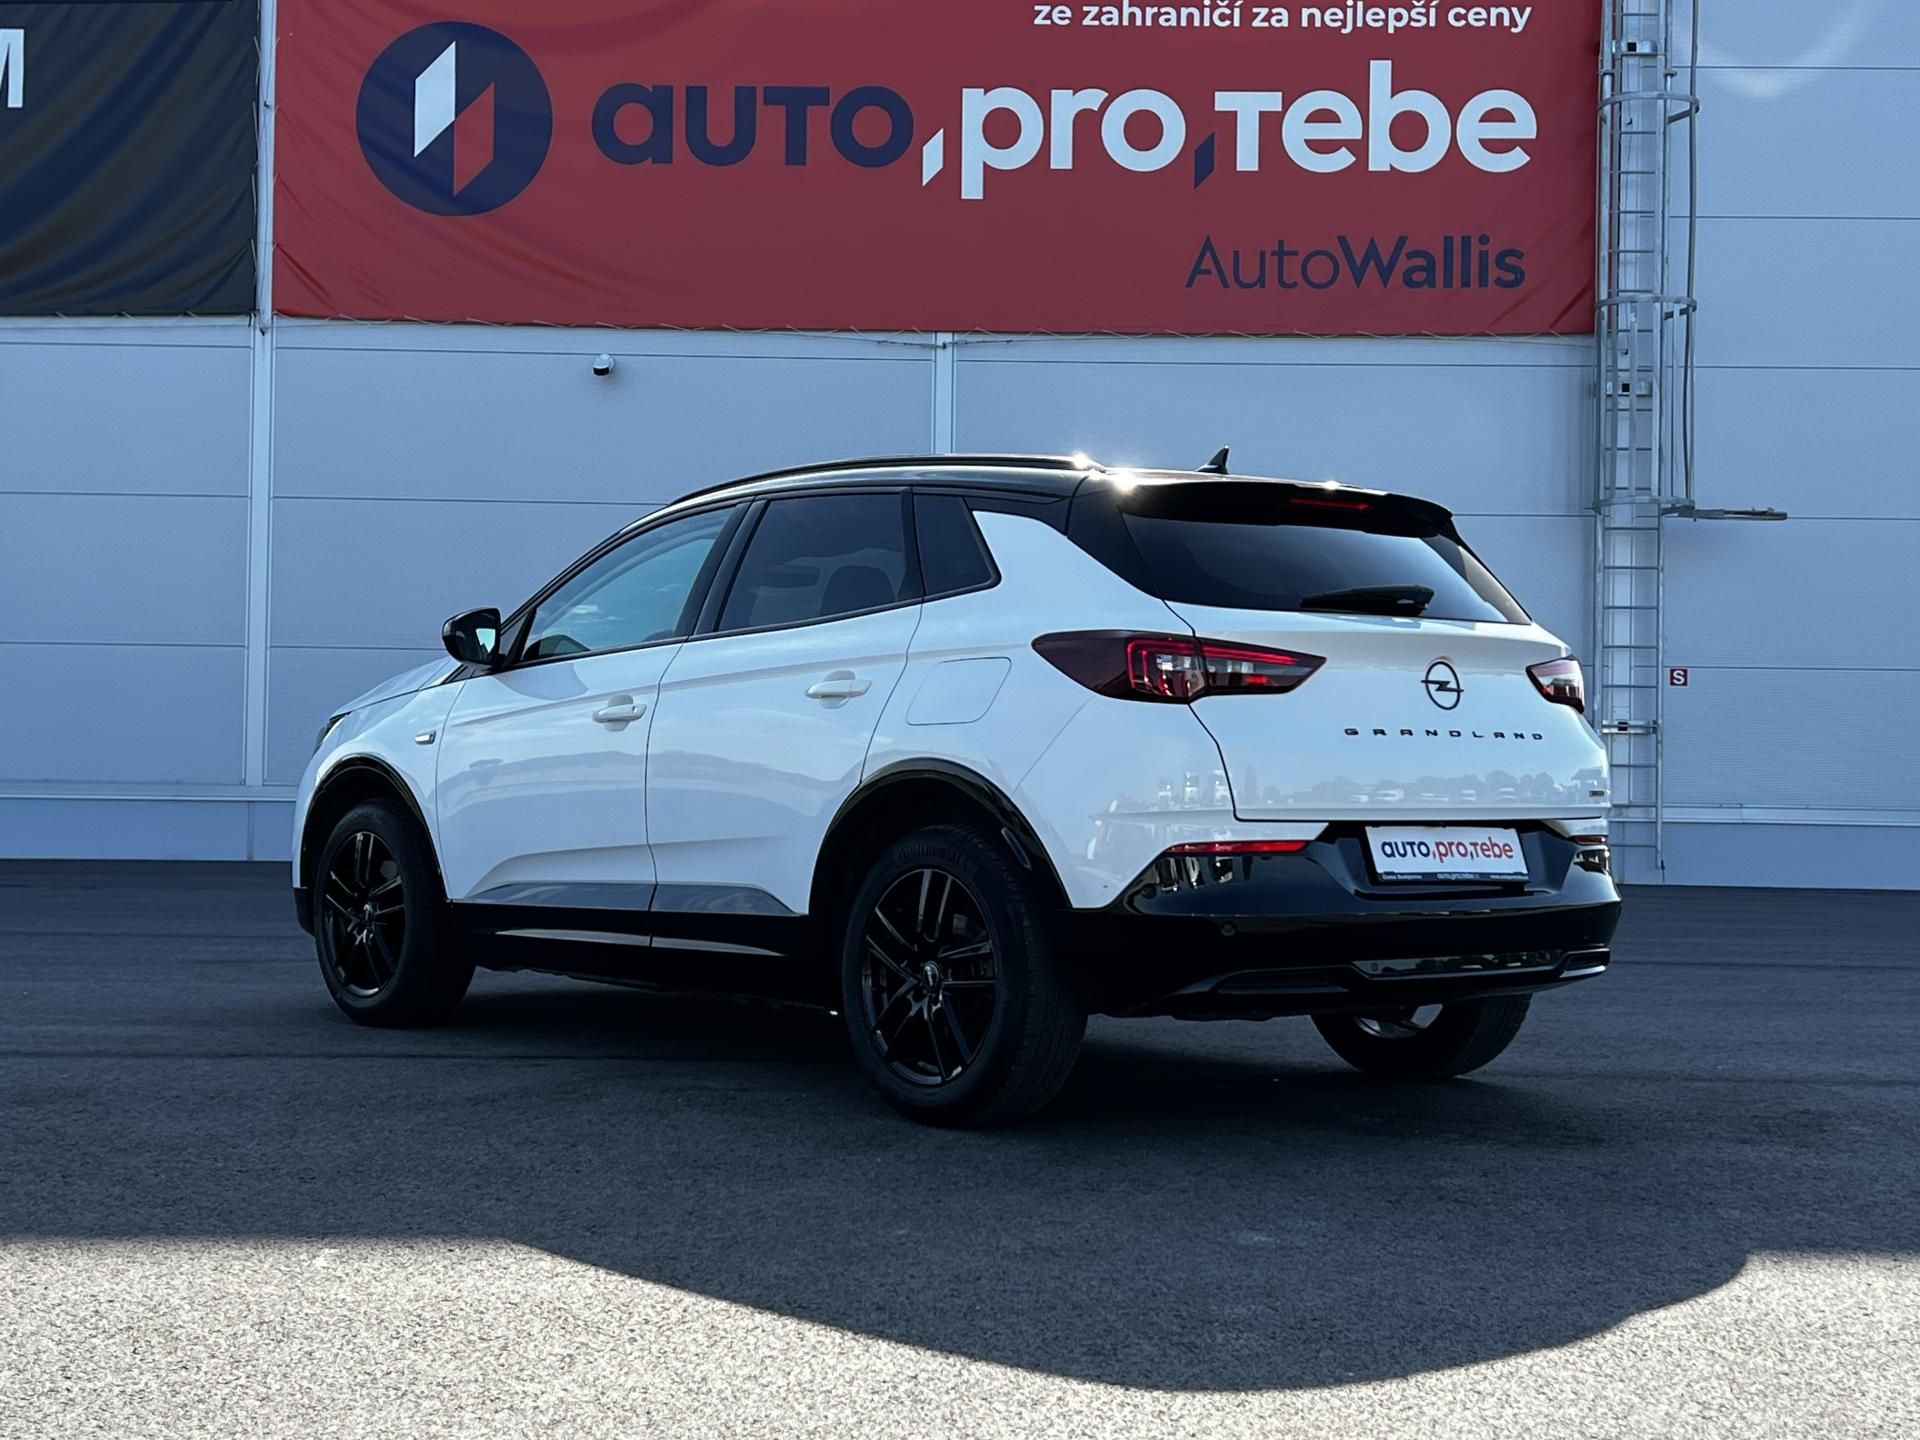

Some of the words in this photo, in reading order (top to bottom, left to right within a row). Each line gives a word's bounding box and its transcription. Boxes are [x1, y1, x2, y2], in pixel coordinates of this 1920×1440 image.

[1033, 5, 1072, 26] ze
[1081, 0, 1244, 28] zahraničí
[1251, 6, 1289, 28] za
[1301, 0, 1440, 34] nejlepší
[1447, 6, 1532, 34] ceny
[1186, 233, 1526, 290] AutoWallis
[1673, 670, 1685, 685] S
[1344, 728, 1544, 741] GRANDLAND
